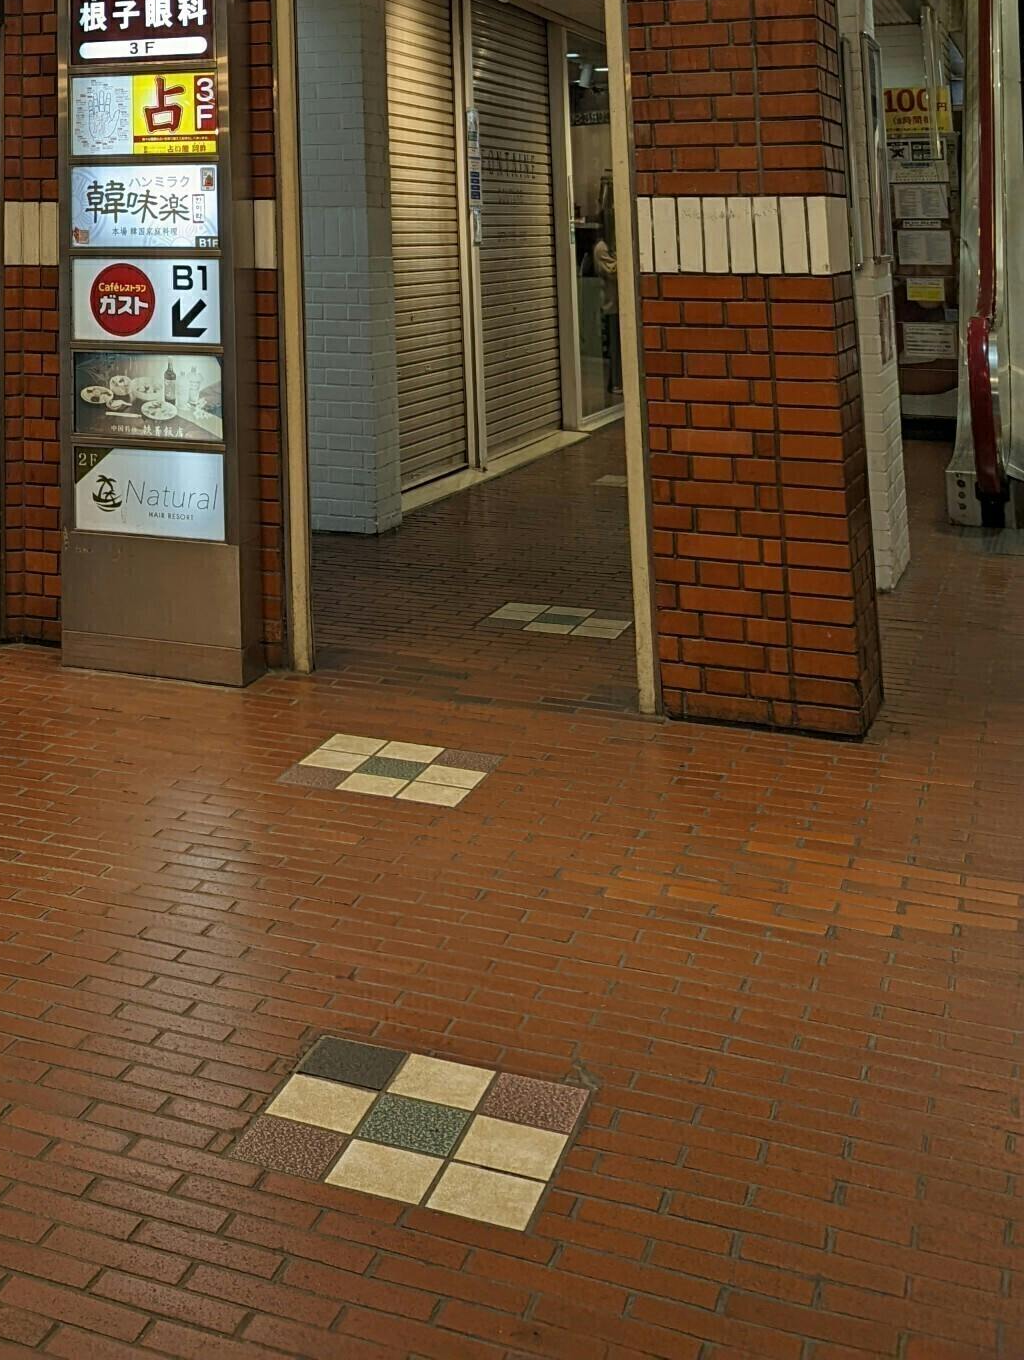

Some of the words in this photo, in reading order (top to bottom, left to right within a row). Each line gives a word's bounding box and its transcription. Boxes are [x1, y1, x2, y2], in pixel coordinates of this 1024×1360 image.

[129, 42, 156, 55] 3F
[143, 76, 185, 134] 占
[195, 77, 215, 130] 3F
[129, 175, 190, 188] ハンミラク
[85, 180, 191, 224] 韓味楽
[172, 264, 208, 291] B1
[99, 295, 149, 316] ガスト
[78, 452, 98, 467] 2F
[125, 479, 218, 513] Natural
